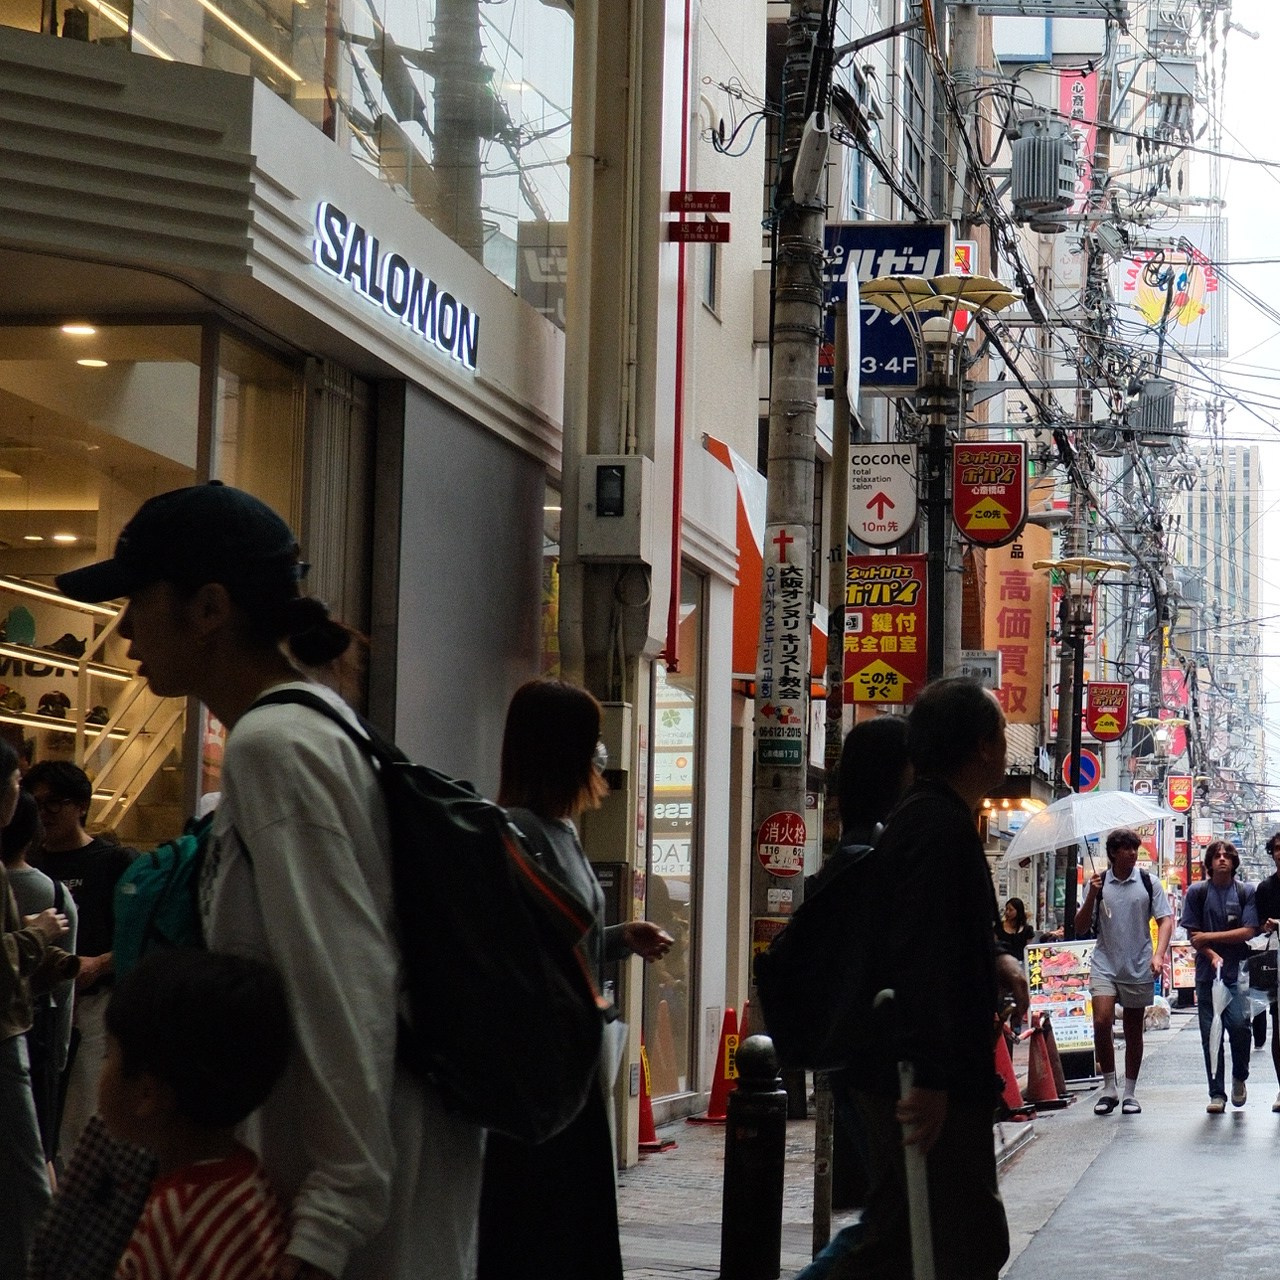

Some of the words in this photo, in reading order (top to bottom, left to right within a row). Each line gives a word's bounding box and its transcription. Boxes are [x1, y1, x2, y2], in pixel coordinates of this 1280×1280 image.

[681, 224, 719, 233] 送水口
[313, 201, 481, 372] SALOMON
[852, 453, 911, 466] cocone
[958, 452, 1020, 466] ネットカフェ
[962, 467, 1016, 485] ポパイ
[975, 510, 1001, 519] この先
[862, 521, 899, 532] 10m先
[847, 565, 913, 581] ネットカフェ
[846, 580, 921, 607] ポパイ
[871, 612, 917, 633] 鍵付
[761, 566, 776, 699] 오사카온누리교회
[845, 635, 917, 653] 完全個室
[996, 570, 1033, 714] 高価買取
[860, 673, 898, 685] この先
[867, 686, 891, 698] すぐ
[765, 822, 805, 844] 消火栓
[764, 846, 780, 855] 116
